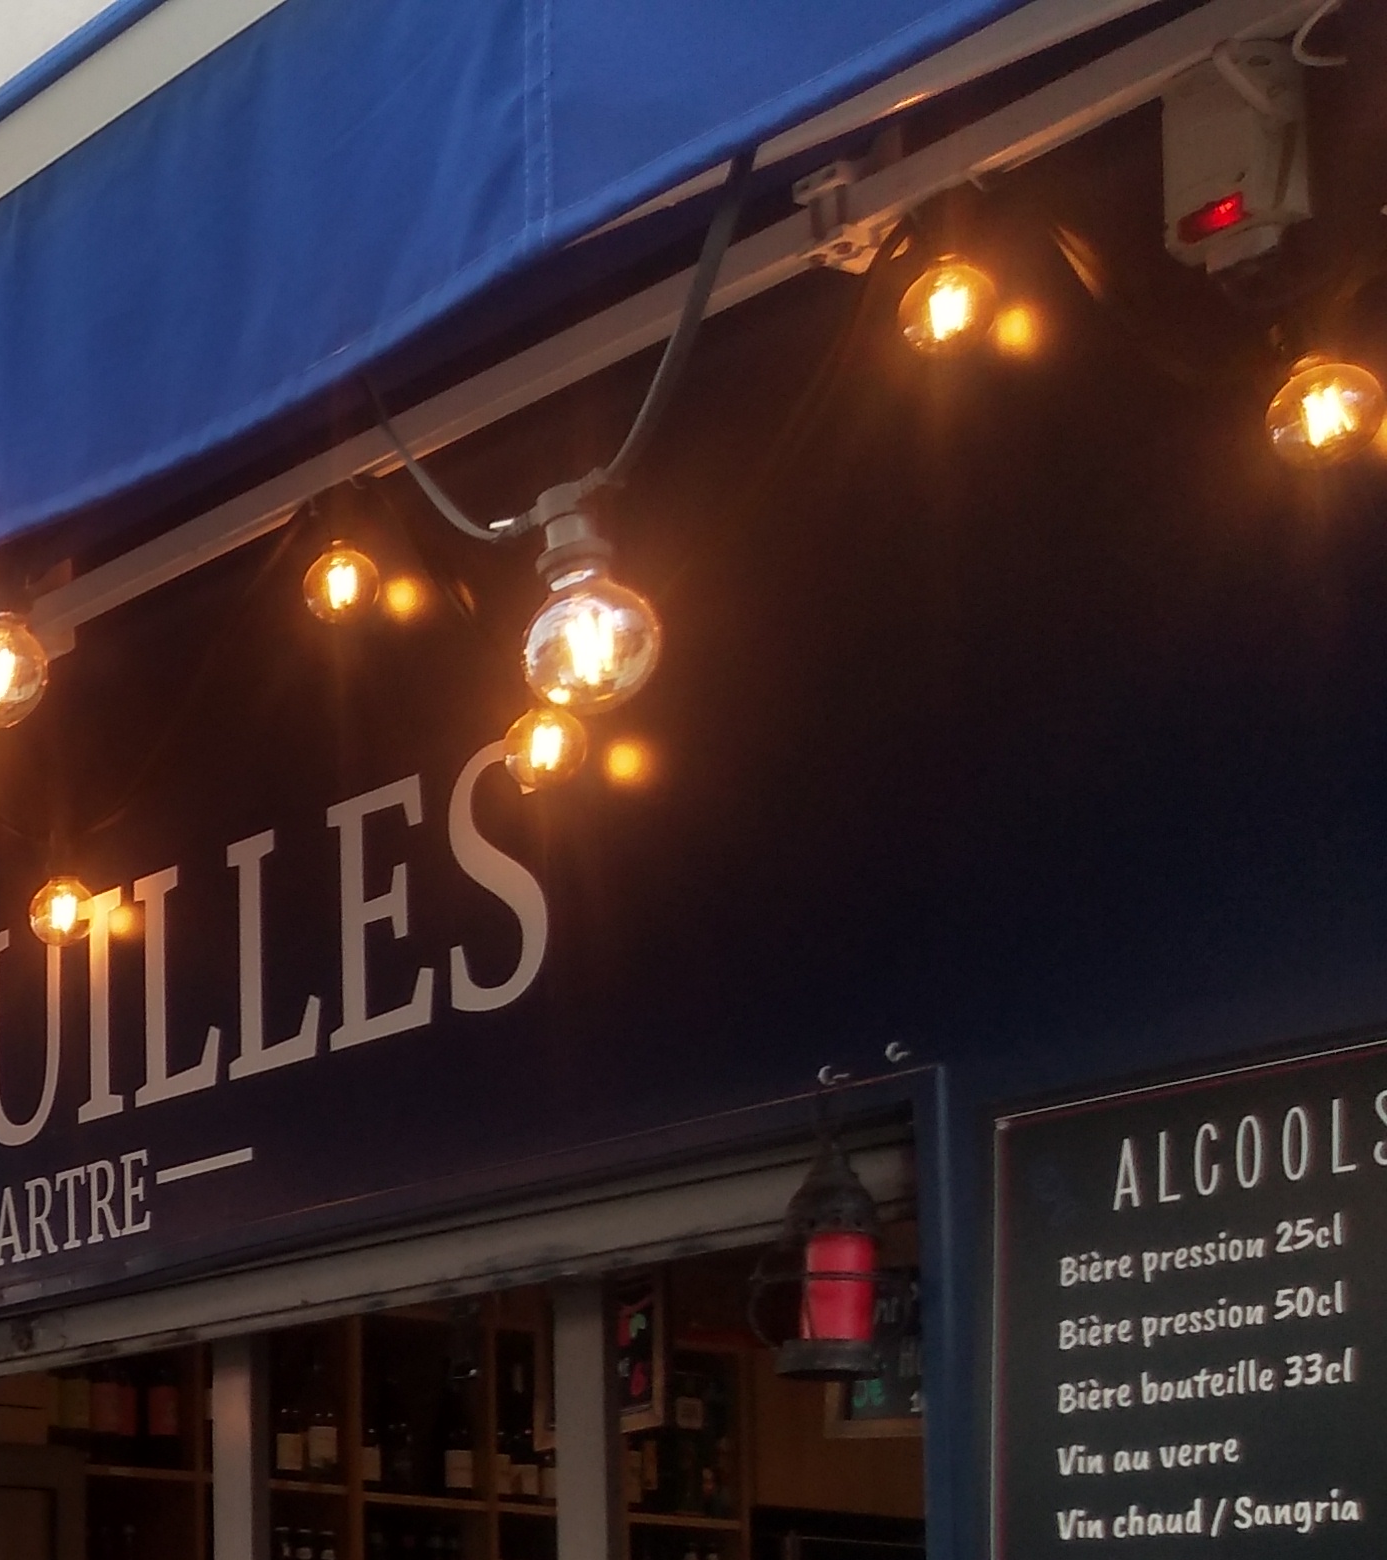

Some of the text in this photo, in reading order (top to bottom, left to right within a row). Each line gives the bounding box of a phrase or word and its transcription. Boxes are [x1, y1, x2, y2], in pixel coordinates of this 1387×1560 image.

[1059, 1212, 1343, 1288] Bière pression 25cl
[1059, 1280, 1344, 1351] Bière pression 50cl
[1057, 1346, 1354, 1415] Bière bouteille 33cl
[1056, 1438, 1240, 1477] Vin au verre
[1056, 1508, 1105, 1541] Vin
[1113, 1498, 1202, 1539] chaud
[1233, 1488, 1361, 1534] Sangria
